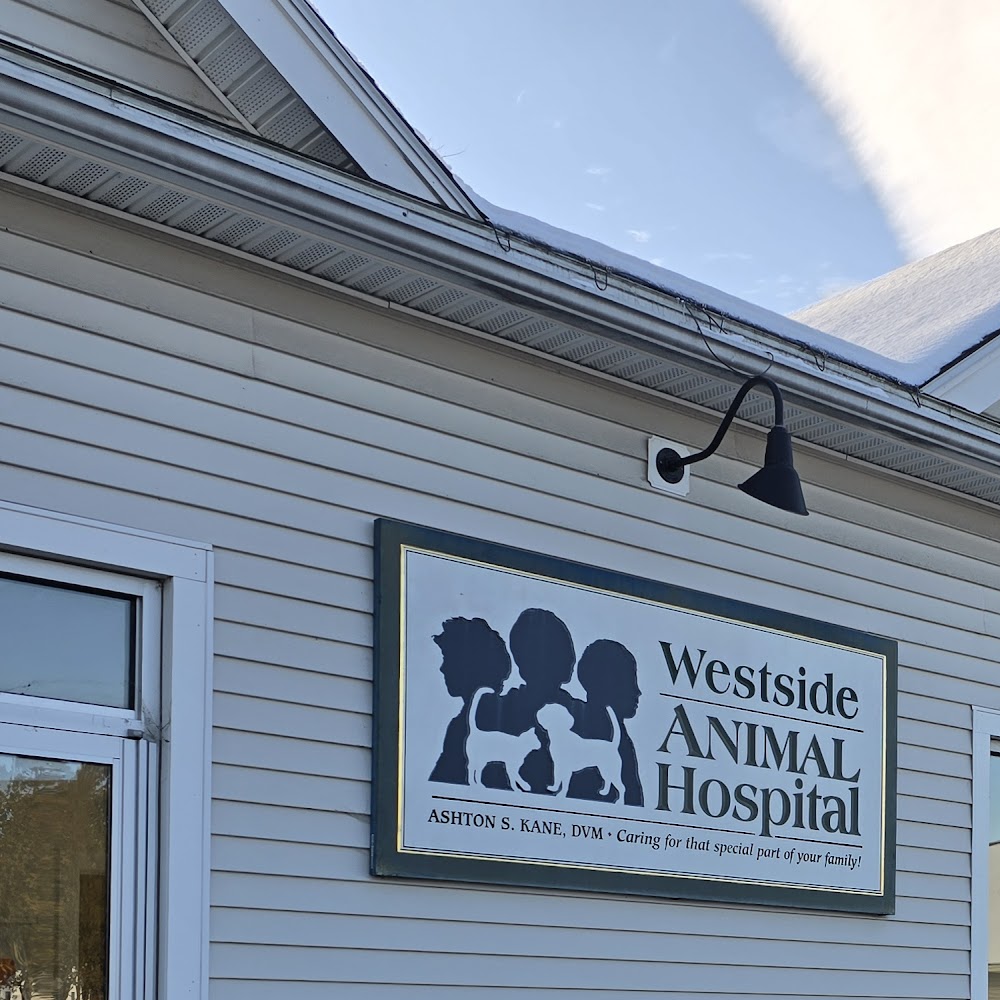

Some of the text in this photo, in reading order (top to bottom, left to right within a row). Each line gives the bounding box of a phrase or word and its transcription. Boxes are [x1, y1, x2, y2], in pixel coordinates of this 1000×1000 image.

[658, 640, 859, 720] Westside
[656, 703, 861, 783] ANIMAL
[655, 761, 862, 838] Hospital
[427, 808, 862, 871] ASHTON S. KANE, DVM Caring for that special part of your family!
